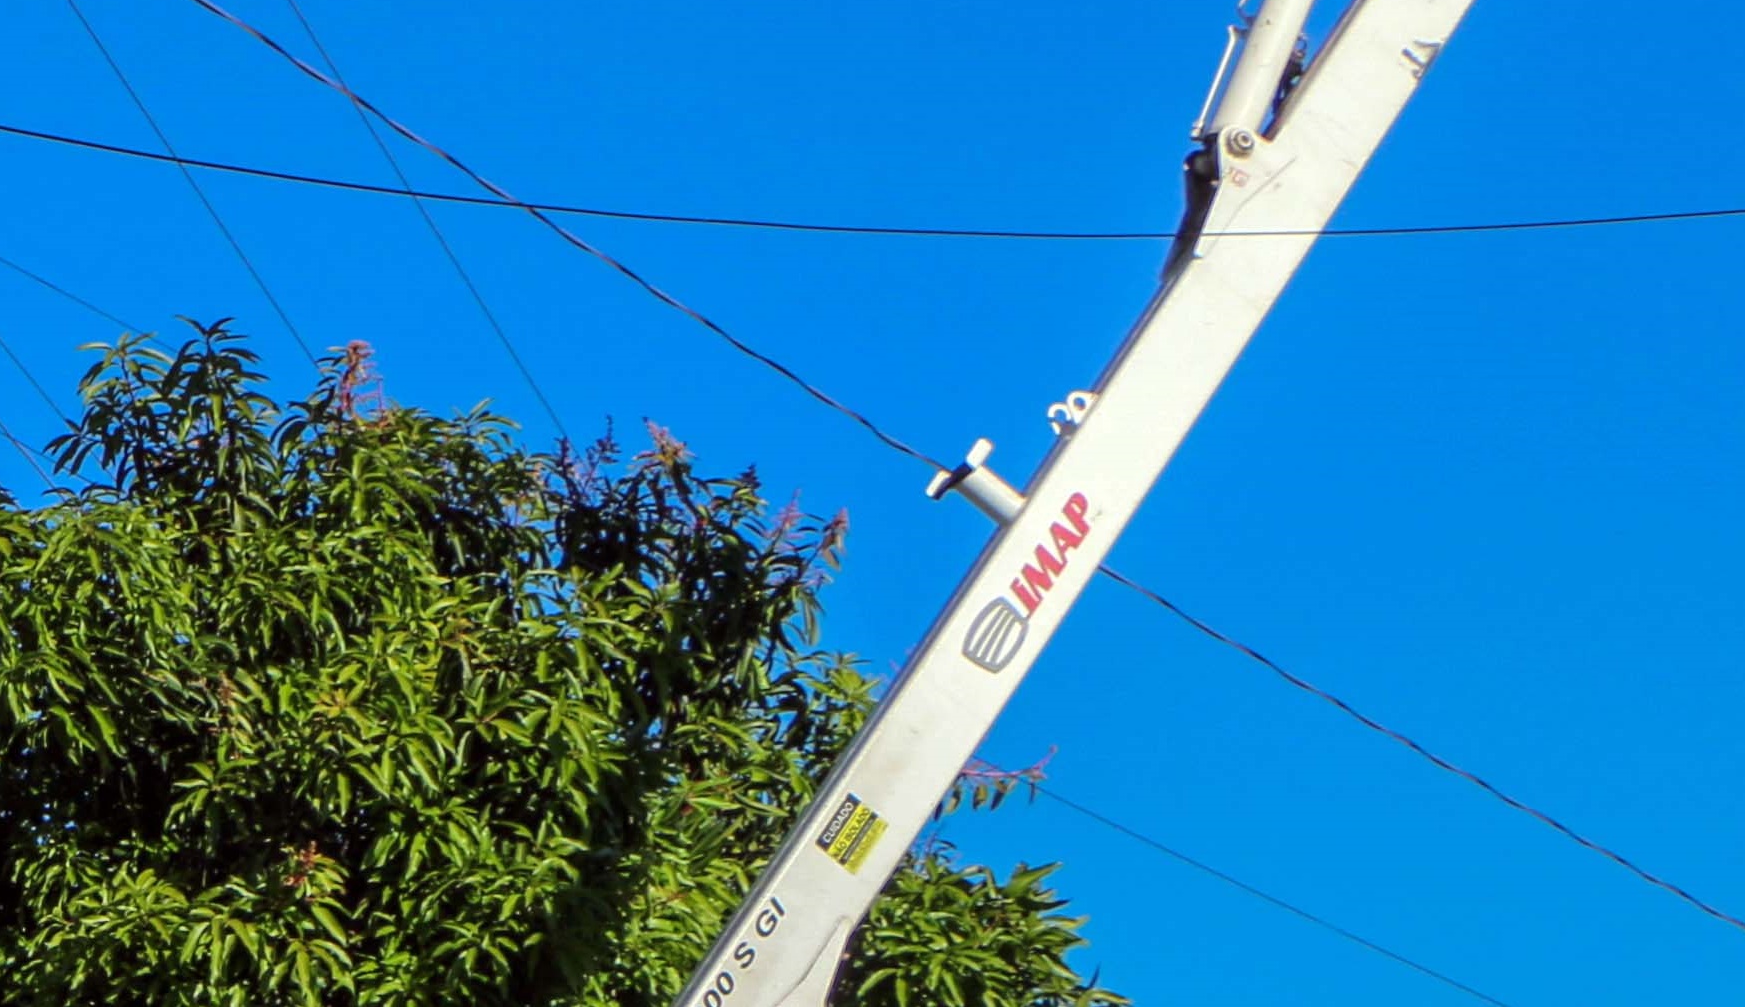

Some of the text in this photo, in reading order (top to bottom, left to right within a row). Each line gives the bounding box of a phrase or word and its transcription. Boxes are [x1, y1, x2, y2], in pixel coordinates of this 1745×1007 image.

[822, 802, 854, 843] CUIDADO
[734, 941, 756, 969] S
[756, 896, 786, 937] GI
